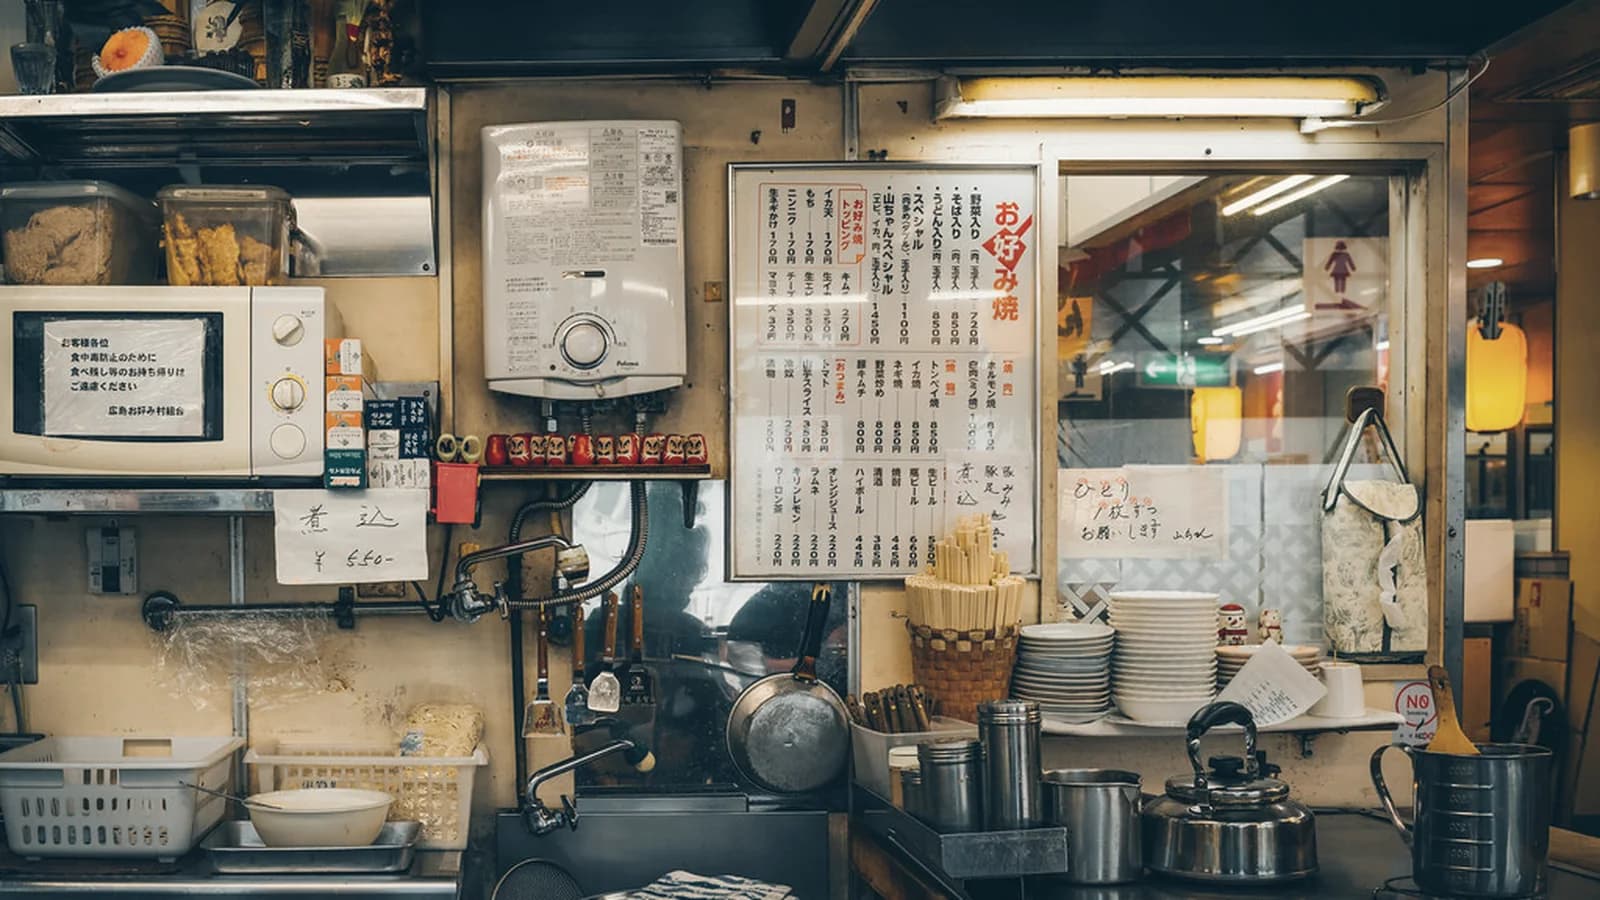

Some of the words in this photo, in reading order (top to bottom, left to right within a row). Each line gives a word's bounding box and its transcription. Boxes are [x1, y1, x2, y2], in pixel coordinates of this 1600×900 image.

[787, 188, 797, 225] ニンニク
[806, 188, 816, 208] もち
[823, 188, 833, 218] イカ天
[841, 200, 851, 250] トッピング
[852, 199, 864, 245] お好み焼
[912, 193, 924, 250] スペシャル
[932, 193, 943, 249] うどん入り
[951, 193, 962, 239] そば入り
[970, 193, 981, 240] 野菜入り
[768, 232, 778, 264] 170円
[787, 232, 796, 264] 170円
[805, 232, 814, 264] 170円
[823, 232, 833, 264] 170円
[992, 201, 1020, 321] お好み焼
[840, 308, 849, 341] 270円
[900, 302, 909, 344] 1100円
[931, 311, 941, 345] 850円
[950, 311, 960, 345] 850円
[969, 311, 979, 345] 720円
[61, 338, 109, 348] お客様各位
[71, 352, 157, 363] 食中毒防止のために
[71, 381, 138, 391] ご遠慮ください
[856, 420, 865, 453] 800円
[874, 420, 883, 453] 800円
[892, 420, 901, 453] 850円
[910, 420, 920, 453] 850円
[928, 420, 938, 453] 850円
[810, 467, 820, 496] ラムネ
[855, 467, 865, 515] ハイボール
[828, 467, 838, 530] オレンジジュース
[773, 533, 782, 566] 220円
[791, 533, 800, 566] 220円
[809, 534, 819, 566] 220円
[827, 534, 837, 567] 220円
[1406, 694, 1430, 709] NO
